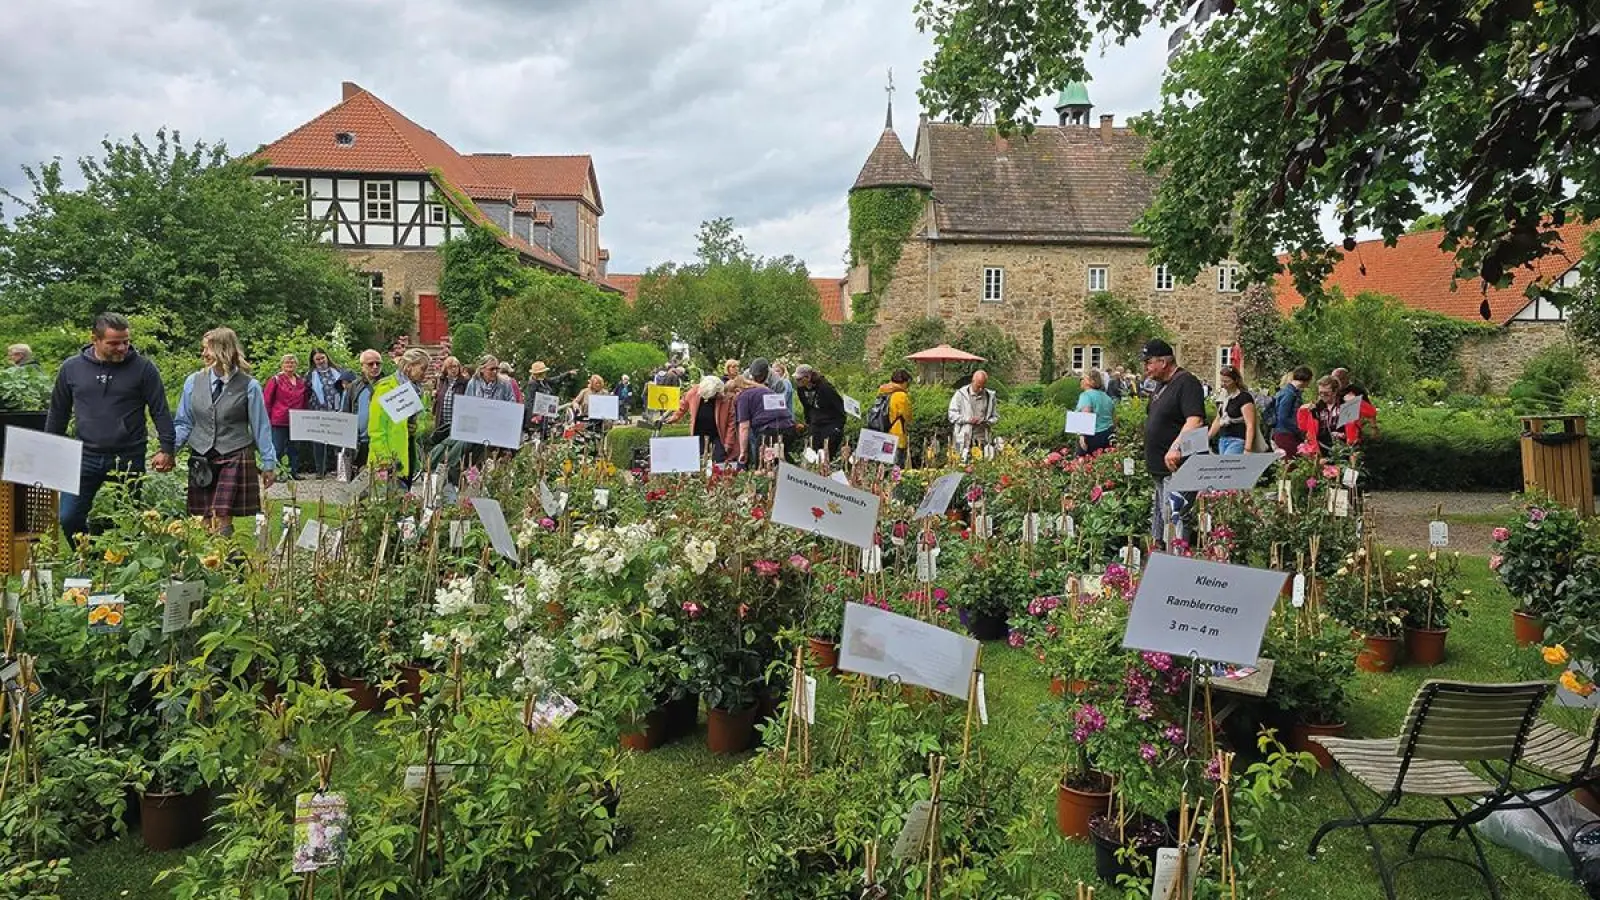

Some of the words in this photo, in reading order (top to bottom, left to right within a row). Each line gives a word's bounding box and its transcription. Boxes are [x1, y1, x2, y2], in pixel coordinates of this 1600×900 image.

[787, 473, 867, 507] Insektenfreundlich
[1195, 575, 1229, 589] Kleine
[1166, 595, 1238, 615] Ramblerrosen
[1169, 620, 1177, 631] 3
[1178, 622, 1189, 632] m
[1199, 624, 1206, 635] 4
[1208, 626, 1220, 637] m
